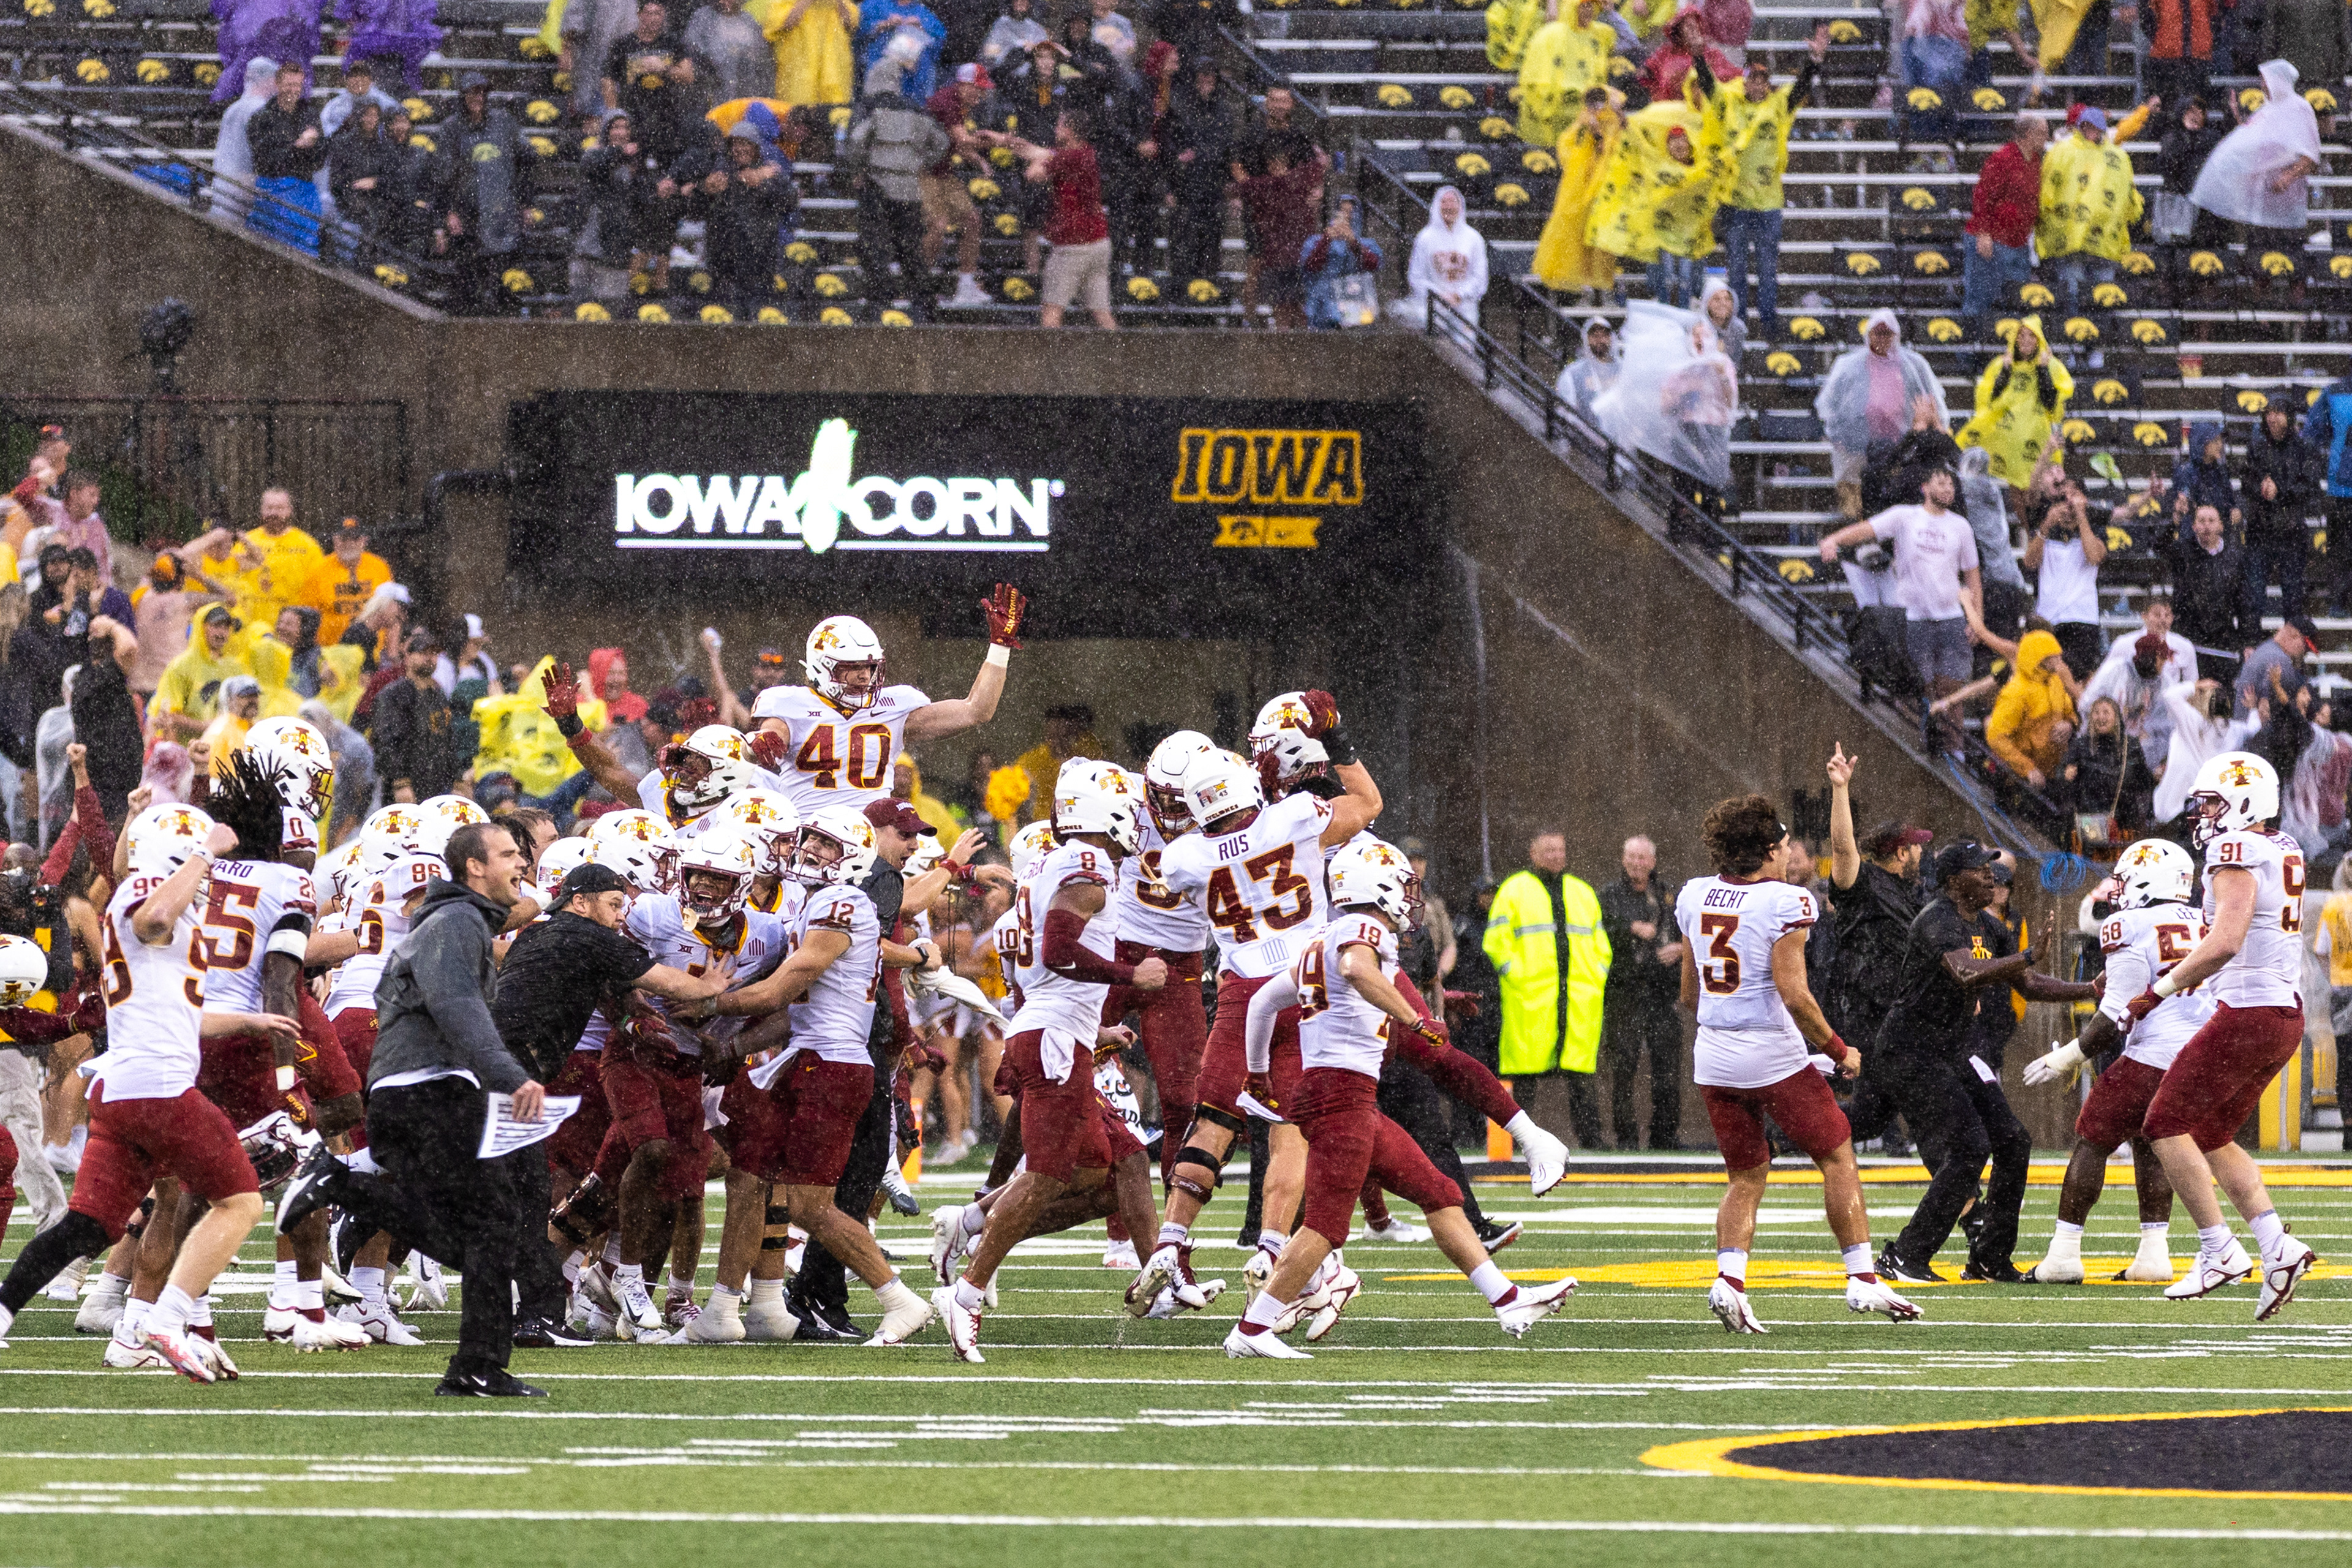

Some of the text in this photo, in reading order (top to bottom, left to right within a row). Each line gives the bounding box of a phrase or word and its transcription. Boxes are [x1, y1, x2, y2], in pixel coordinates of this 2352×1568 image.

[1171, 427, 1364, 505] IOWA
[615, 473, 1050, 535] IOWA CORN
[1268, 709, 1311, 725] STATE
[796, 723, 891, 790] 40
[2219, 766, 2263, 784] STATE
[733, 804, 777, 821] STATE
[619, 821, 663, 838] STATE
[1218, 834, 1250, 861] RUS
[2220, 842, 2242, 862] 91
[1080, 851, 1096, 871] 8
[412, 863, 442, 883] 86
[1207, 842, 1312, 944] 43
[1704, 889, 1748, 908] BECHT
[827, 900, 854, 925] 12
[1799, 896, 1811, 916] 3
[2176, 908, 2197, 919] LEE
[999, 929, 1018, 949] 10
[1357, 922, 1381, 947] 19
[2102, 921, 2122, 944] 58
[1701, 912, 1741, 995] 3
